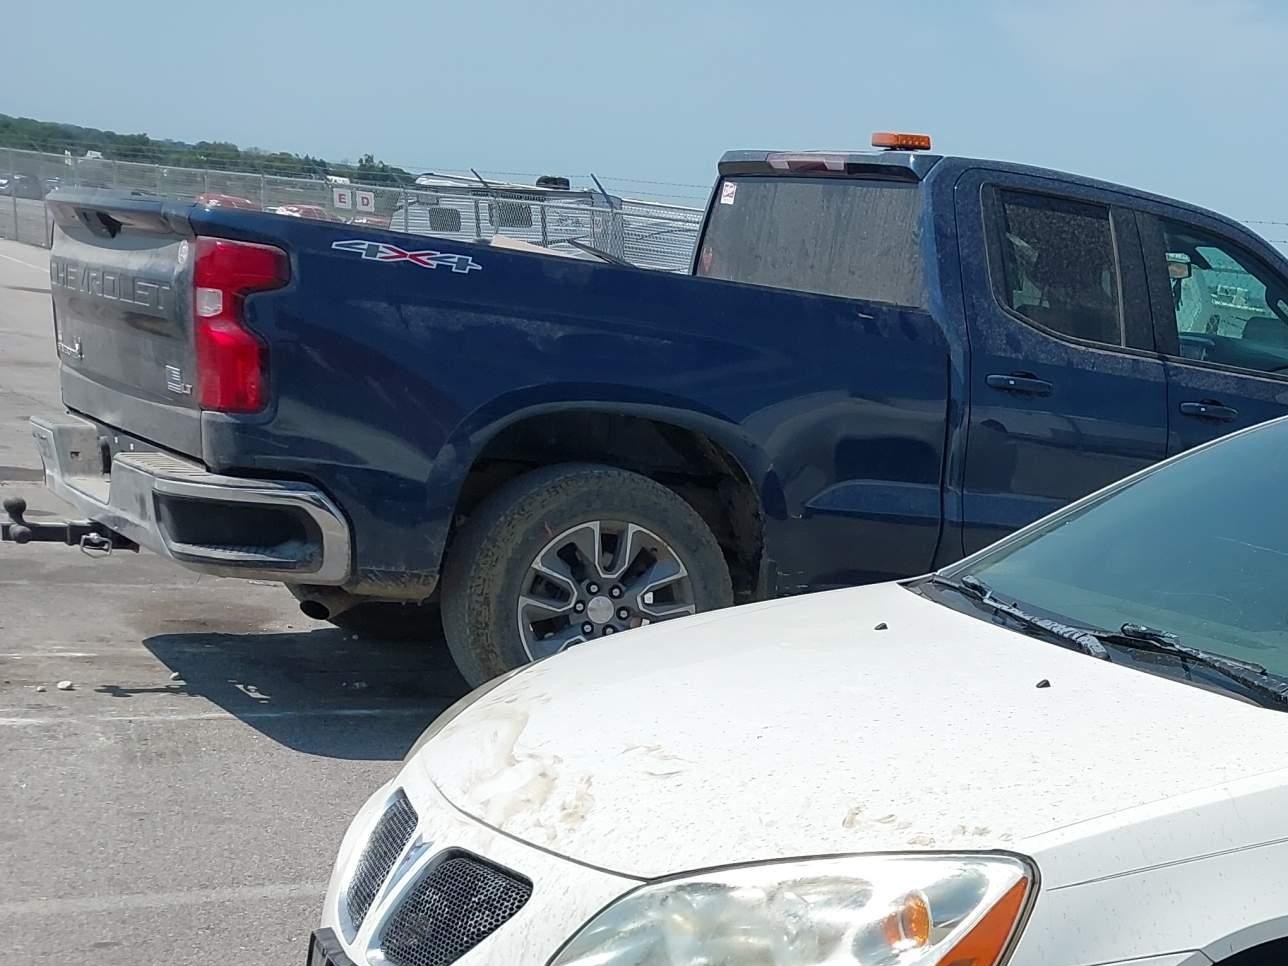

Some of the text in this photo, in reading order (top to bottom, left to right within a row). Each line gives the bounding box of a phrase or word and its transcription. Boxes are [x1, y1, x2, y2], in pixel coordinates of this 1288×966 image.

[338, 193, 370, 206] E D
[51, 261, 171, 310] CHEVROLET
